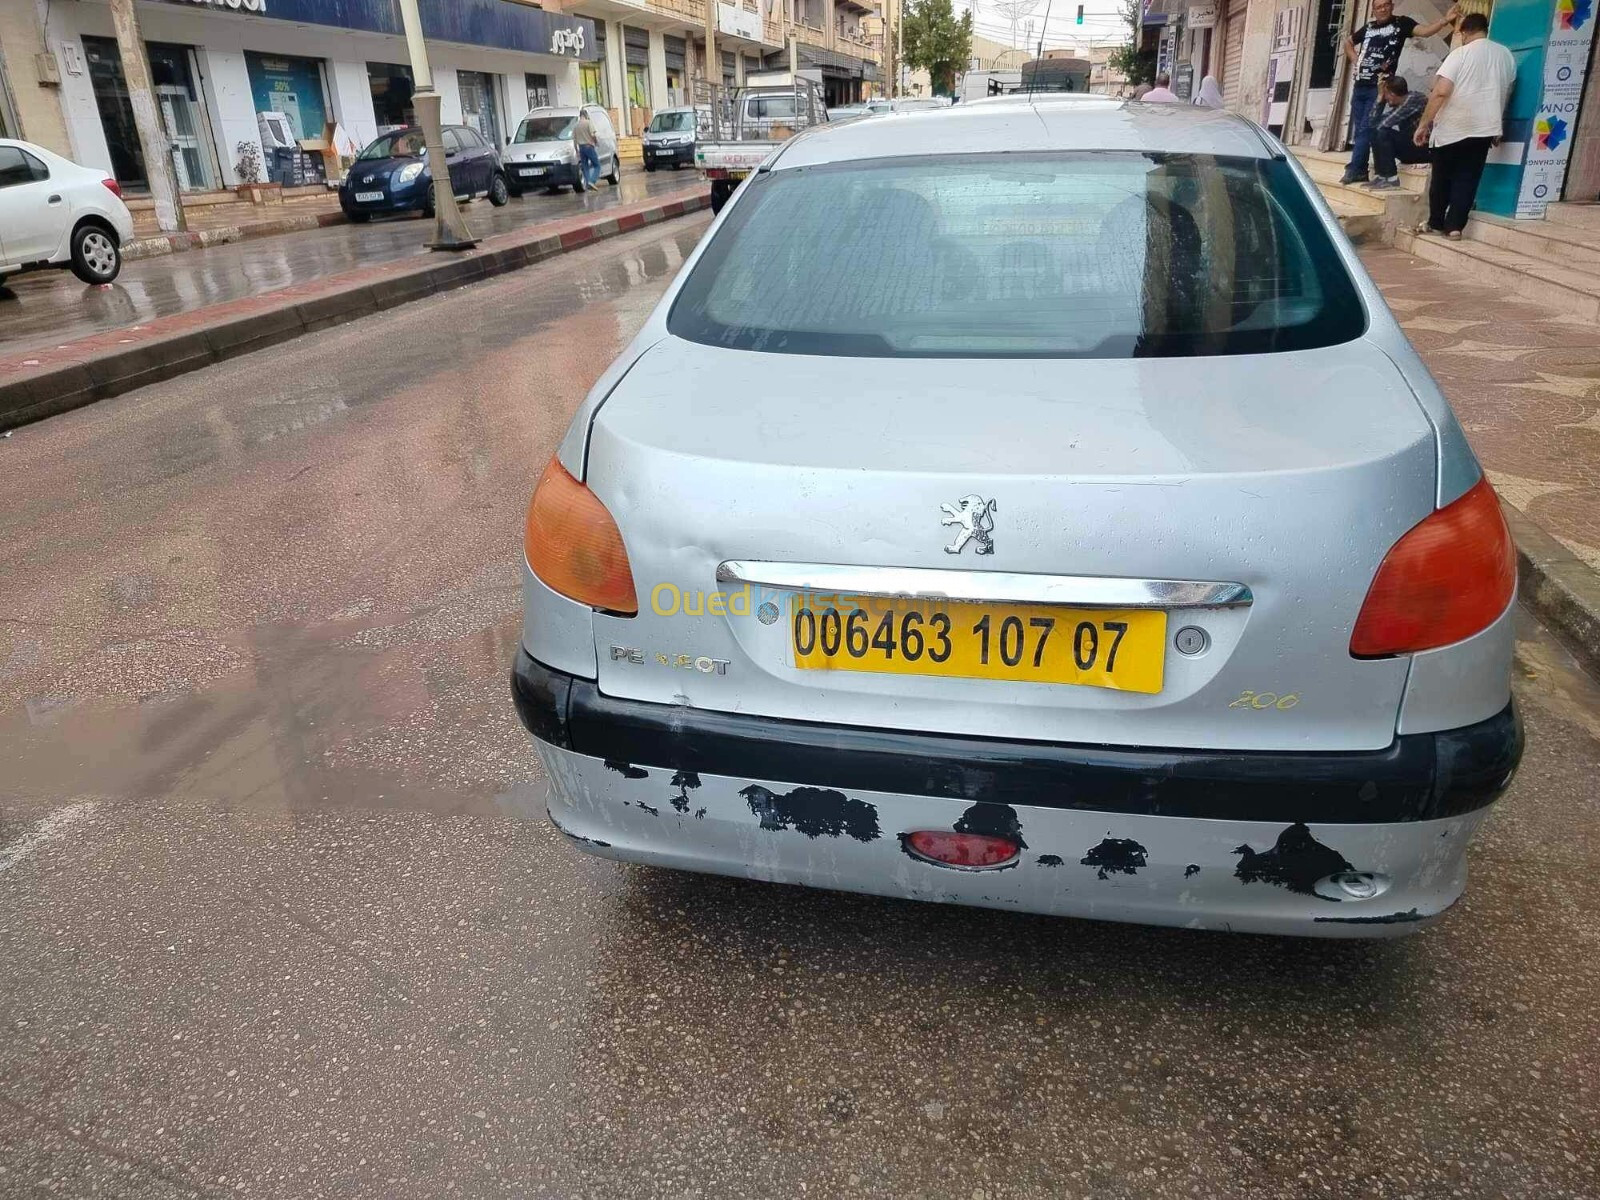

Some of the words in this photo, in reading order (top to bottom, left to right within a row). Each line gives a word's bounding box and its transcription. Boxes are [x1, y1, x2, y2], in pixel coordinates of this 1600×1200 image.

[550, 26, 585, 57] كوندور
[274, 81, 290, 91] 50%
[794, 607, 952, 663] 006463
[972, 614, 1056, 667] 107
[1073, 621, 1129, 673] 07
[1228, 690, 1303, 711] 206
